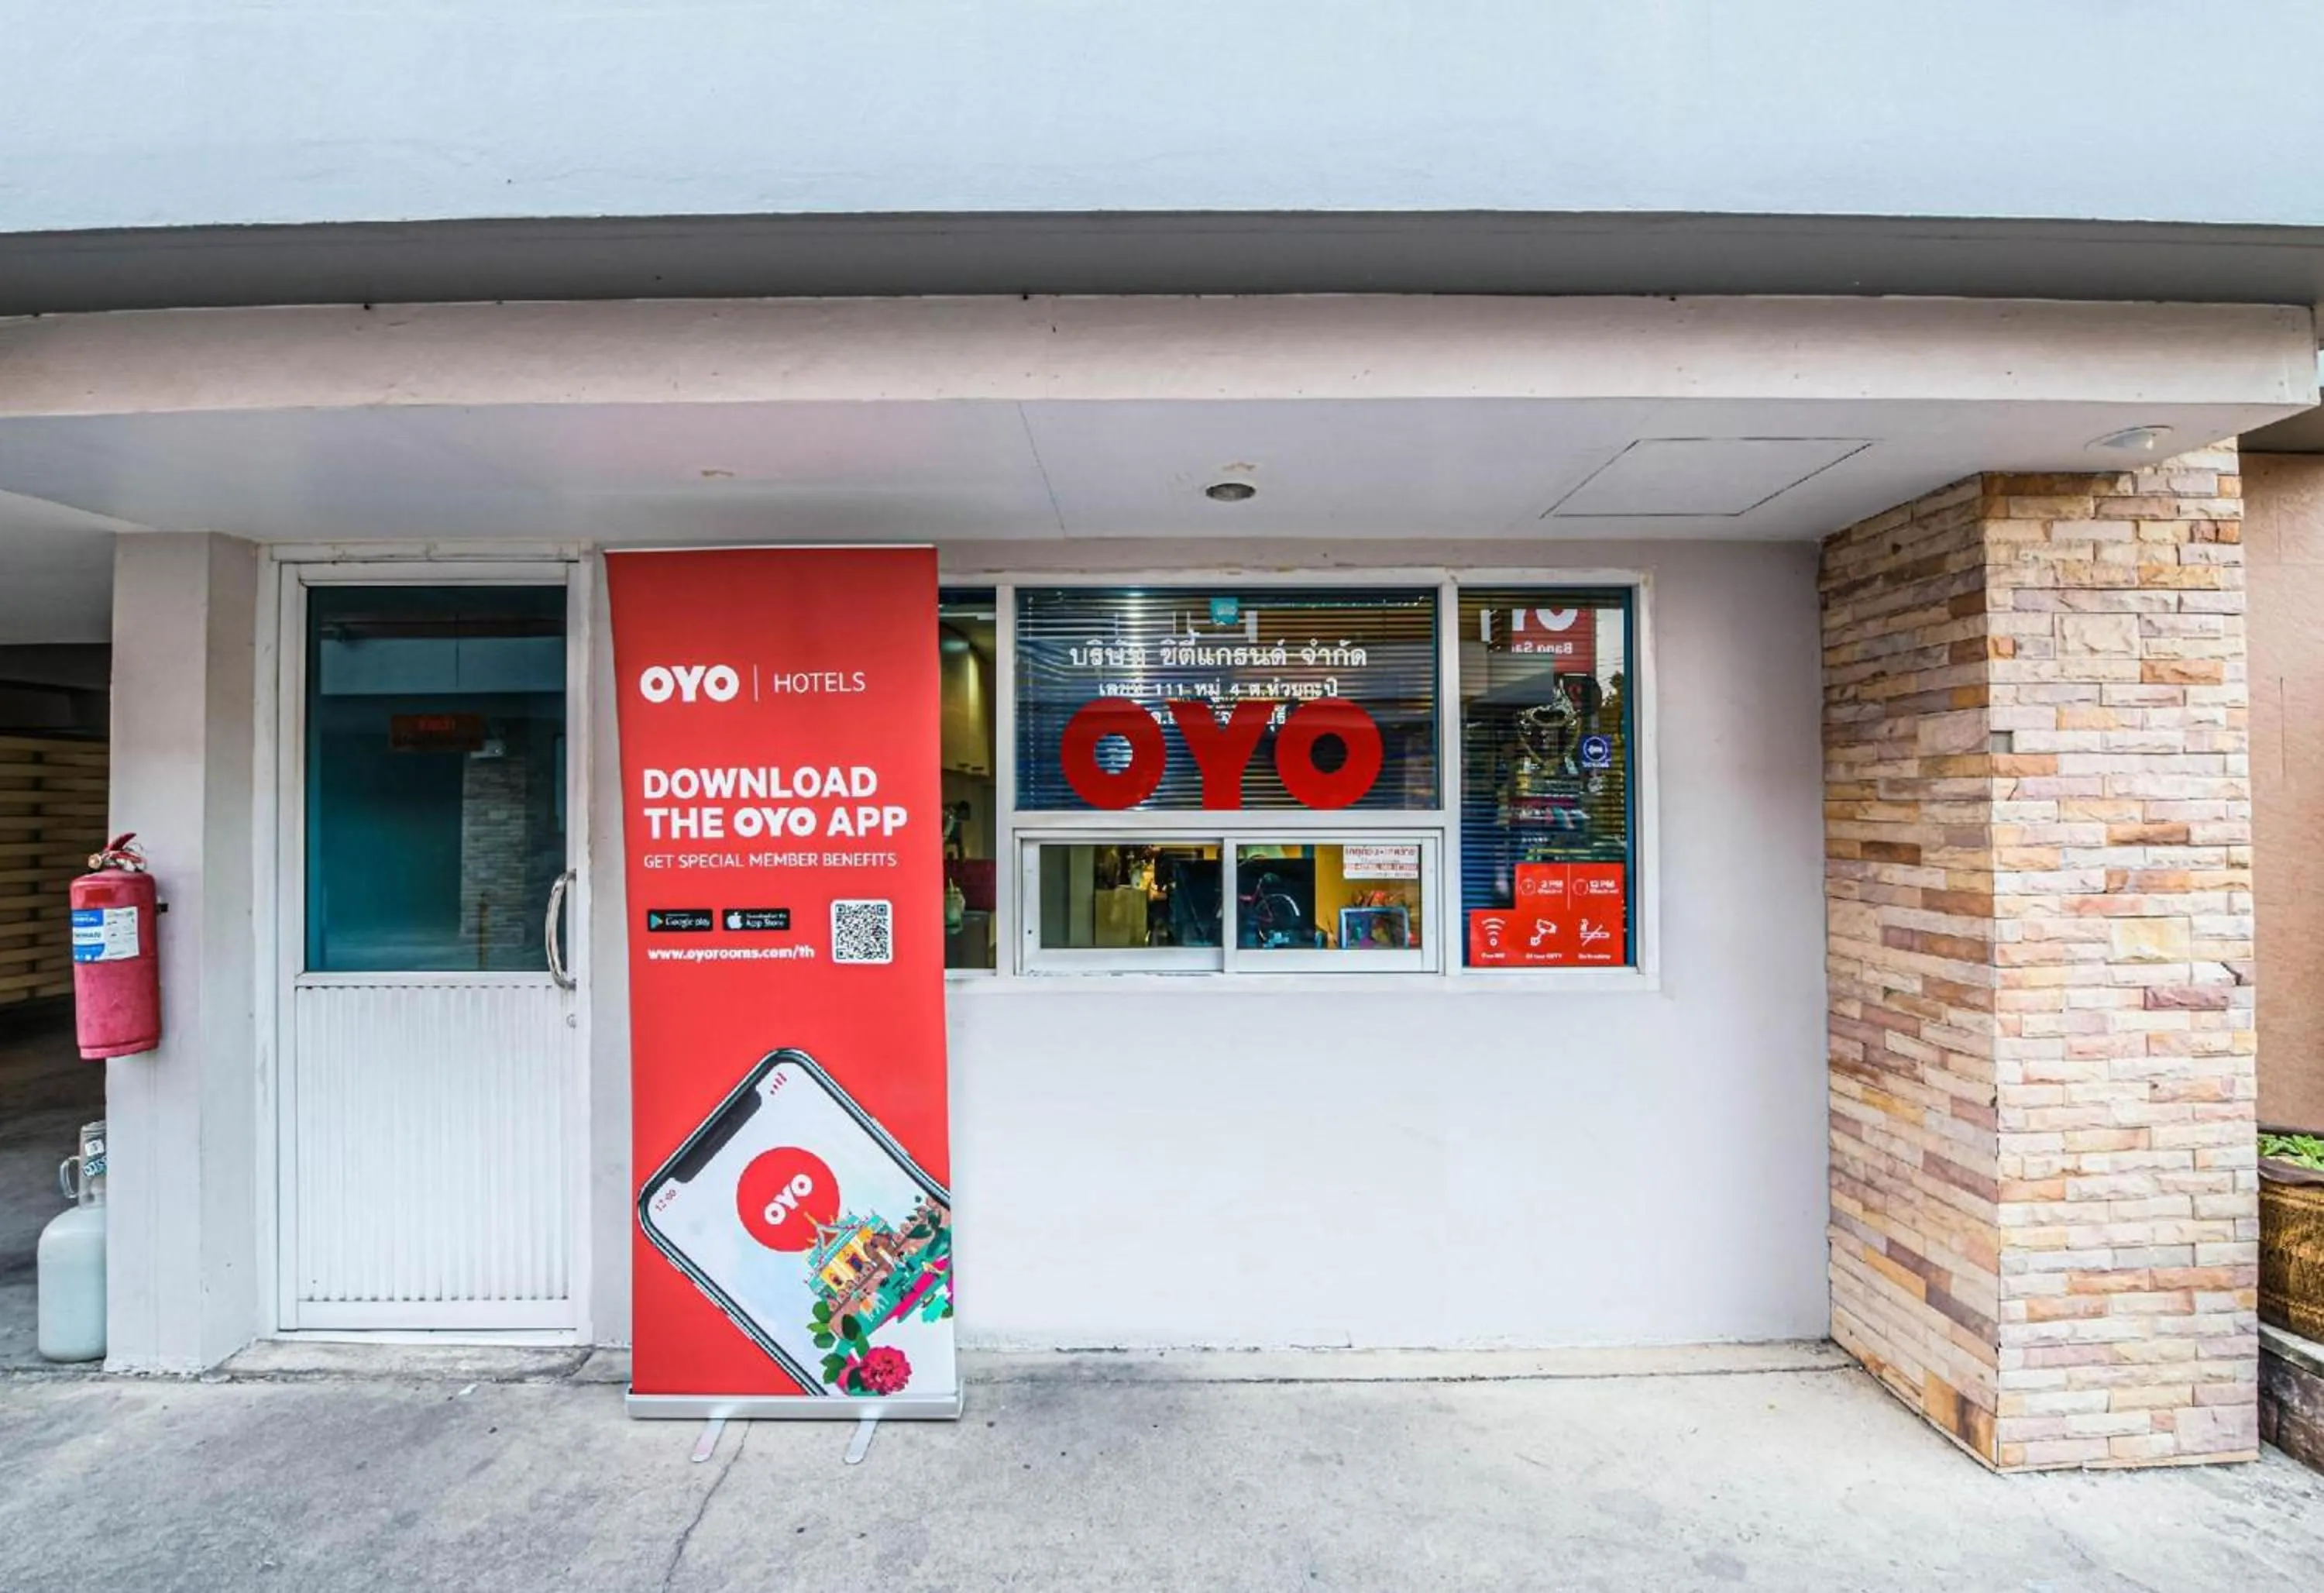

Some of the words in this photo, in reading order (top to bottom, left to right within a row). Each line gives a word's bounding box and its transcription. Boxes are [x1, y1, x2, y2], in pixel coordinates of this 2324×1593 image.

[1301, 638, 1367, 666] จำกัด
[639, 664, 740, 703] OYO
[775, 672, 866, 693] HOTELS
[1060, 697, 1384, 810] OYO
[643, 766, 878, 799] DOWNLOAD
[644, 807, 724, 839] THE
[734, 807, 816, 838] OYO
[827, 806, 908, 837] APP
[644, 855, 673, 869] GET
[679, 854, 744, 868] SPECIAL
[749, 853, 817, 867] MEMBER
[823, 852, 897, 867] BENEFITS
[648, 944, 815, 963] www.oyorooms.com/th
[764, 1173, 813, 1225] OYO
